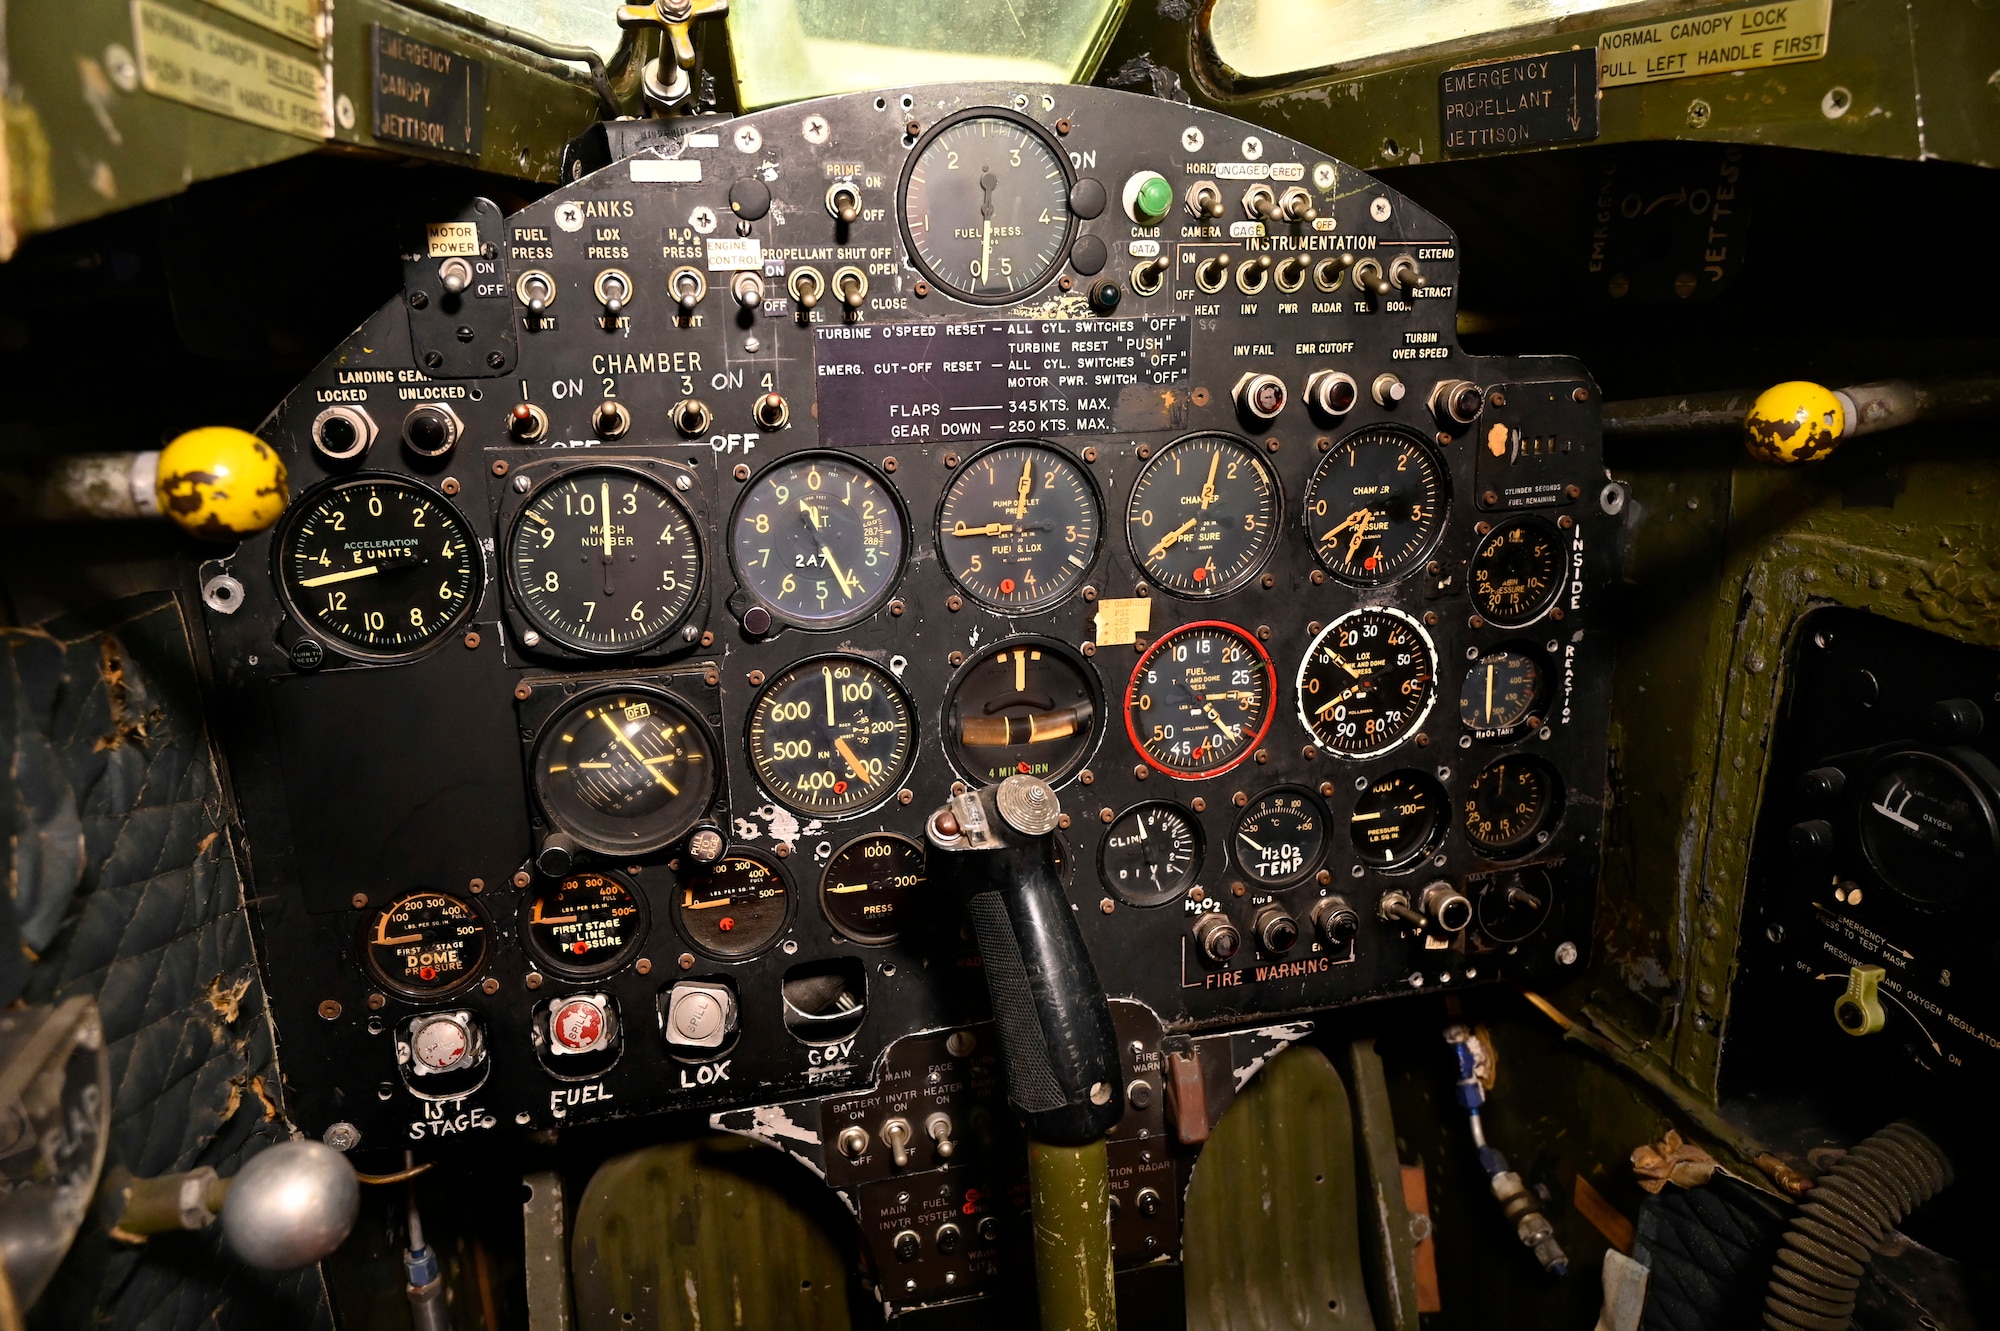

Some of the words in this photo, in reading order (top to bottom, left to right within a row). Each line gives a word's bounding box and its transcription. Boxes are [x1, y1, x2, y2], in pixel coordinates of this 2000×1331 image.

[1602, 28, 1662, 50] NORMAL
[1671, 16, 1733, 40] CANOPY
[1740, 7, 1786, 29] LOCK
[380, 36, 452, 76] EMERGENCY
[1600, 60, 1636, 80] PULL
[1647, 53, 1685, 73] LEFT
[1698, 41, 1762, 66] HANDLE
[1773, 34, 1823, 56] FIRST
[1444, 61, 1549, 93] EMERGENCY
[379, 70, 430, 106] CANOPY
[1446, 90, 1552, 119] PROPELLANT
[381, 113, 444, 144] JETTISON
[1446, 123, 1530, 148] JETTISON
[826, 164, 862, 177] PRIME
[1186, 163, 1216, 175] HORIZ
[1216, 165, 1269, 176] UNCAGED
[1272, 167, 1302, 177] ERECT
[865, 176, 881, 188] ON
[577, 201, 634, 218] TANKS
[863, 209, 885, 221] OFF
[1233, 225, 1263, 237] CAGE
[1316, 219, 1333, 230] OFF
[429, 225, 472, 240] MOTOR
[515, 229, 548, 241] FUEL
[597, 229, 621, 241] LOX
[955, 228, 981, 238] FUEL
[989, 226, 1024, 236] PRESS.
[1131, 227, 1160, 238] CALIB
[1181, 226, 1221, 238] CAMERA
[430, 240, 475, 254] POWER
[708, 241, 747, 252] ENGINE
[1131, 244, 1157, 254] DATA
[1246, 236, 1377, 251] INSTRUMENTATION
[512, 247, 553, 259] PRESS
[588, 247, 629, 258] PRESS
[663, 247, 702, 258] PRESS
[761, 248, 832, 260] PROPELLANT
[838, 248, 867, 260] SHUT
[870, 248, 891, 258] OFF
[1182, 253, 1196, 264] ON
[1418, 248, 1455, 260] EXTEND
[709, 255, 761, 266] CONTROL
[475, 262, 495, 275] ON
[766, 264, 785, 277] ON
[869, 263, 898, 275] OPEN
[476, 283, 504, 296] OFF
[1176, 289, 1194, 300] OFF
[1412, 286, 1452, 298] RETRACT
[764, 300, 787, 312] OFF
[872, 298, 907, 310] CLOSE
[1194, 304, 1220, 316] HEAT
[1241, 304, 1257, 315] INV
[1278, 303, 1298, 315] PWR
[1312, 302, 1342, 314] RADAR
[795, 311, 823, 323] FUEL
[817, 328, 871, 340] TURBINE
[883, 325, 936, 337] O'SPEED
[946, 324, 986, 336] RESET
[1008, 322, 1031, 334] ALL
[1042, 323, 1070, 334] CYL.
[1076, 320, 1134, 333] SWITCHES
[1143, 315, 1186, 332] "OFF"
[1009, 341, 1061, 353] TURBINE
[1071, 340, 1108, 351] RESET
[1118, 335, 1172, 350] "PUSH"
[1405, 332, 1437, 344] TURBIN
[1234, 345, 1250, 356] INV
[1253, 344, 1274, 356] FAIL
[1296, 343, 1316, 355] EMR
[1318, 342, 1355, 354] CUTOFF
[1392, 348, 1416, 360] OVER
[1418, 347, 1448, 359] SPEED
[592, 353, 702, 375] CHAMBER
[818, 364, 864, 376] EMERG.
[874, 362, 932, 373] CUT-OFF
[943, 361, 982, 372] RESET
[1008, 359, 1036, 370] ALL
[1044, 358, 1073, 369] CYL.
[1077, 356, 1134, 368] SWITCHES
[1141, 352, 1186, 366] "OFF"
[711, 372, 743, 391] ON
[1008, 376, 1048, 388] MOTOR
[1059, 374, 1087, 386] PWR.
[1095, 373, 1137, 385] SWITCH
[1146, 369, 1187, 384] "OFF"
[317, 388, 368, 402] LOCKED
[399, 385, 465, 401] UNLOCKED
[552, 380, 583, 399] ON
[890, 404, 940, 418] FLAPS
[1008, 399, 1037, 413] 345
[1039, 398, 1070, 412] KTS.
[1077, 398, 1110, 411] MAX.
[891, 424, 930, 437] GEAR
[941, 422, 981, 435] DOWN
[1009, 420, 1035, 433] 250
[1040, 419, 1070, 431] KTS.
[1077, 418, 1109, 430] MAX.
[710, 434, 760, 454] OFF
[1505, 487, 1532, 495] CYLINDER
[1535, 484, 1561, 493] SECONDS
[566, 494, 595, 515] 1.0
[1508, 498, 1523, 506] FUEL
[1526, 496, 1556, 505] REMAINING
[344, 539, 418, 549] ACCELERATION
[795, 554, 827, 567] 2A7
[329, 591, 347, 611] 12
[364, 611, 384, 631] 10
[1363, 625, 1378, 637] 30
[1196, 640, 1210, 653] 15
[1186, 668, 1206, 676] FUEL
[1232, 670, 1249, 685] 25
[842, 682, 872, 702] 100
[627, 706, 647, 718] OFF
[771, 701, 811, 722] 600
[871, 720, 894, 733] 200
[1154, 725, 1174, 741] 50
[1336, 723, 1356, 738] 90
[773, 740, 811, 760] 500
[797, 771, 835, 790] 400
[1922, 813, 1953, 831] OXYGEN
[1368, 826, 1399, 836] PRESSURE
[691, 834, 703, 856] PULL
[701, 839, 710, 852] TO
[707, 837, 720, 860] CAGE
[864, 845, 891, 857] 1000
[1255, 857, 1303, 877] TEMP
[405, 901, 423, 910] 200
[427, 899, 445, 908] 300
[864, 904, 893, 914] PRESS
[612, 908, 629, 916] 500
[553, 924, 583, 935] FIRST
[586, 919, 620, 930] STAGE
[1838, 914, 1886, 946] EMERGENCY
[577, 930, 605, 940] LINE
[397, 947, 421, 956] FIRST
[436, 941, 463, 950] STAGE
[408, 951, 458, 967] DOME
[1206, 970, 1243, 989] FIRE
[1256, 958, 1328, 982] WARNING
[1796, 961, 1812, 975] OFF
[1906, 990, 1943, 1016] OXYGEN
[809, 1040, 855, 1065] GOV
[1135, 1053, 1158, 1062] FIRE
[928, 1062, 953, 1072] FACE
[1948, 1054, 1962, 1067] ON
[681, 1060, 731, 1088] LOX
[885, 1070, 911, 1081] MAIN
[551, 1083, 613, 1110] FUEL
[833, 1097, 881, 1112] BATTERY
[885, 1090, 917, 1103] INVTR
[923, 1083, 963, 1097] HEATER
[935, 1095, 950, 1104] ON
[894, 1102, 908, 1112] ON
[850, 1110, 865, 1119] ON
[409, 1108, 485, 1139] STAGE
[1138, 1161, 1170, 1173] RADAR
[923, 1199, 949, 1209] FUEL
[880, 1206, 907, 1217] MAIN
[879, 1216, 912, 1230] INVTR
